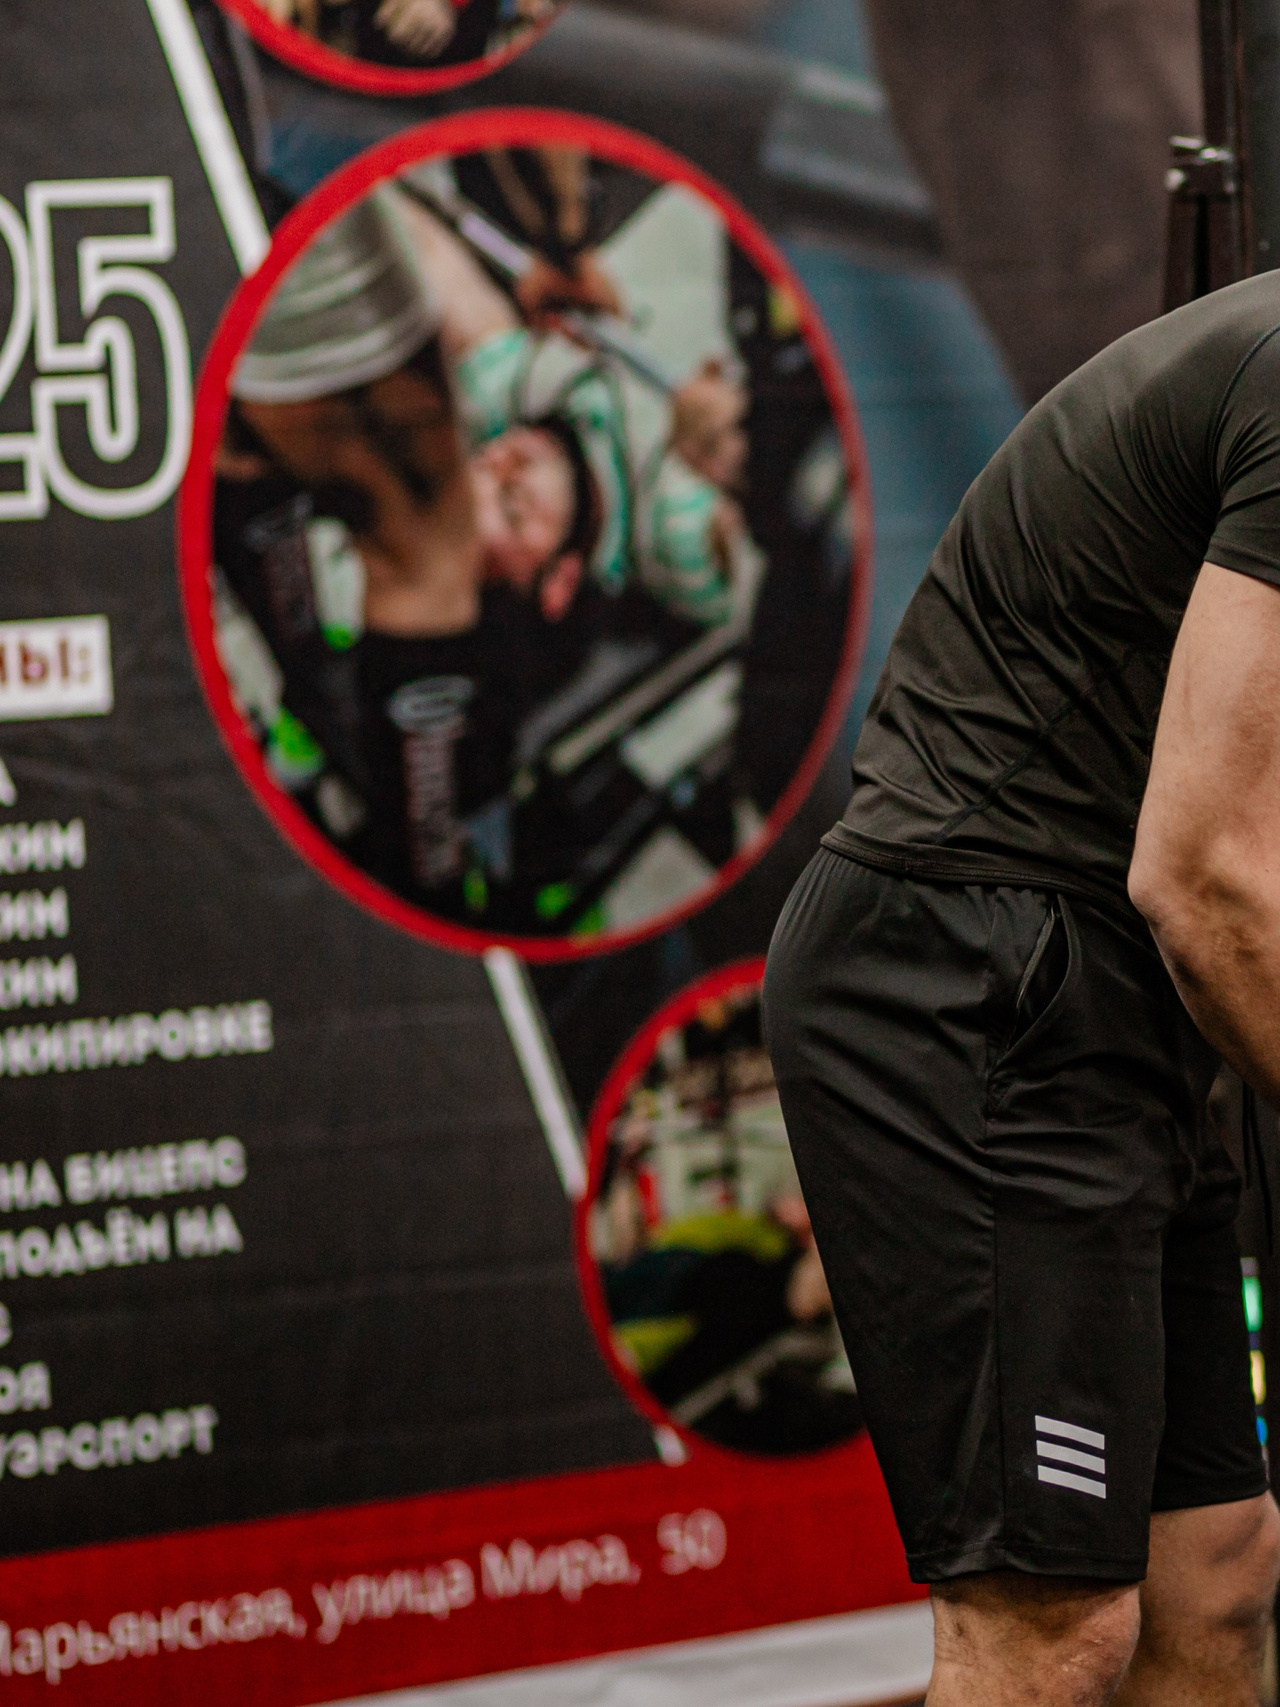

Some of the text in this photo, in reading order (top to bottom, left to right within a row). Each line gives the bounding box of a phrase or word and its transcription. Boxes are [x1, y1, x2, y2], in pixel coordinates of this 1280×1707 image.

[0, 634, 91, 690] Ы:
[0, 1000, 273, 1077] КИПИРОВКЕ
[0, 1404, 218, 1481] ЭРСПОРТ
[312, 1558, 476, 1644] улица
[480, 1534, 641, 1602] Мира,
[656, 1508, 727, 1575] 50
